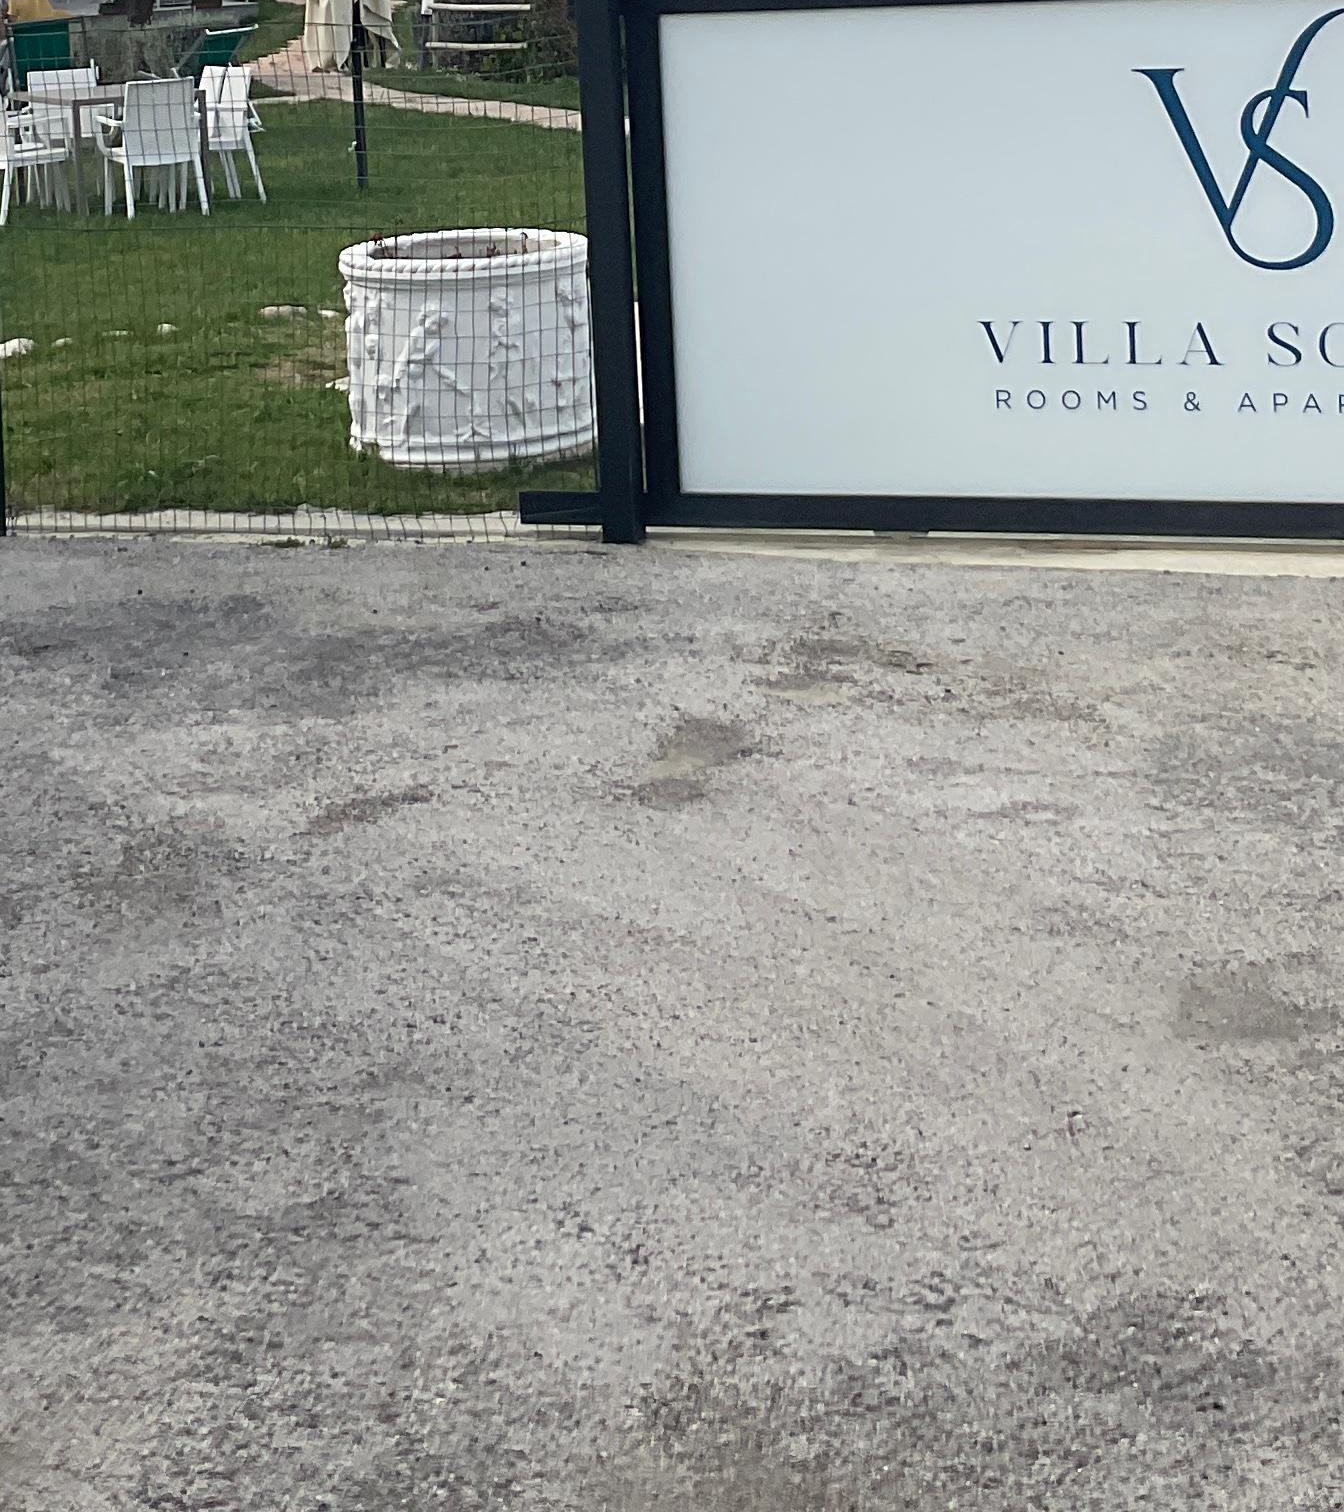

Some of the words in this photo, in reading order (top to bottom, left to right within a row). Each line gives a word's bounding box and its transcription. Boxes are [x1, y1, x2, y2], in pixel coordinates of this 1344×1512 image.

[977, 320, 1224, 365] VILLA
[995, 389, 1149, 411] ROOMS
[1183, 391, 1201, 412] &
